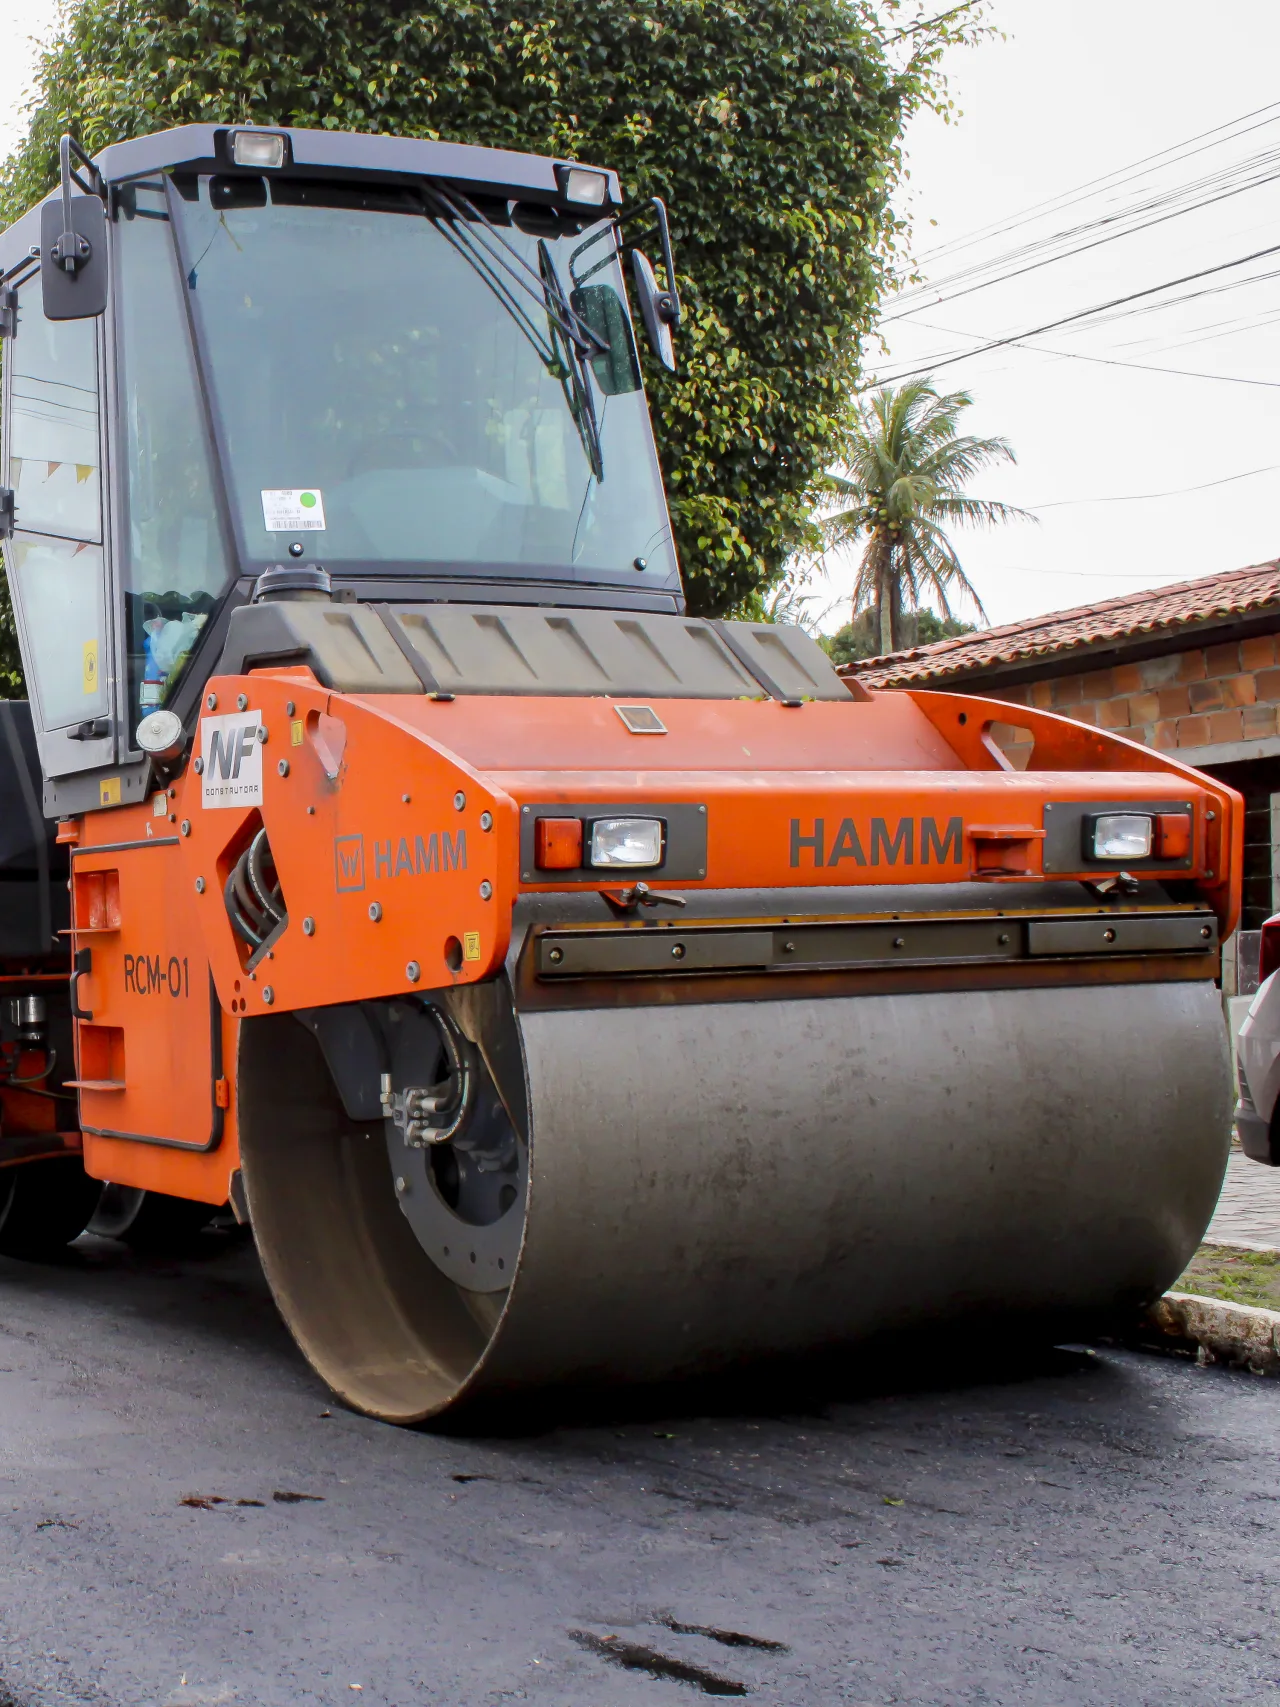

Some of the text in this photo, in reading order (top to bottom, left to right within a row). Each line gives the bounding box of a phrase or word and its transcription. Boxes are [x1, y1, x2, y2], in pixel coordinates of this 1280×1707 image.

[207, 725, 258, 780] NF
[205, 785, 259, 796] CONSTRUTORA
[374, 829, 468, 879] HAMM
[789, 816, 963, 868] HAMM
[123, 953, 189, 998] RCM-01
